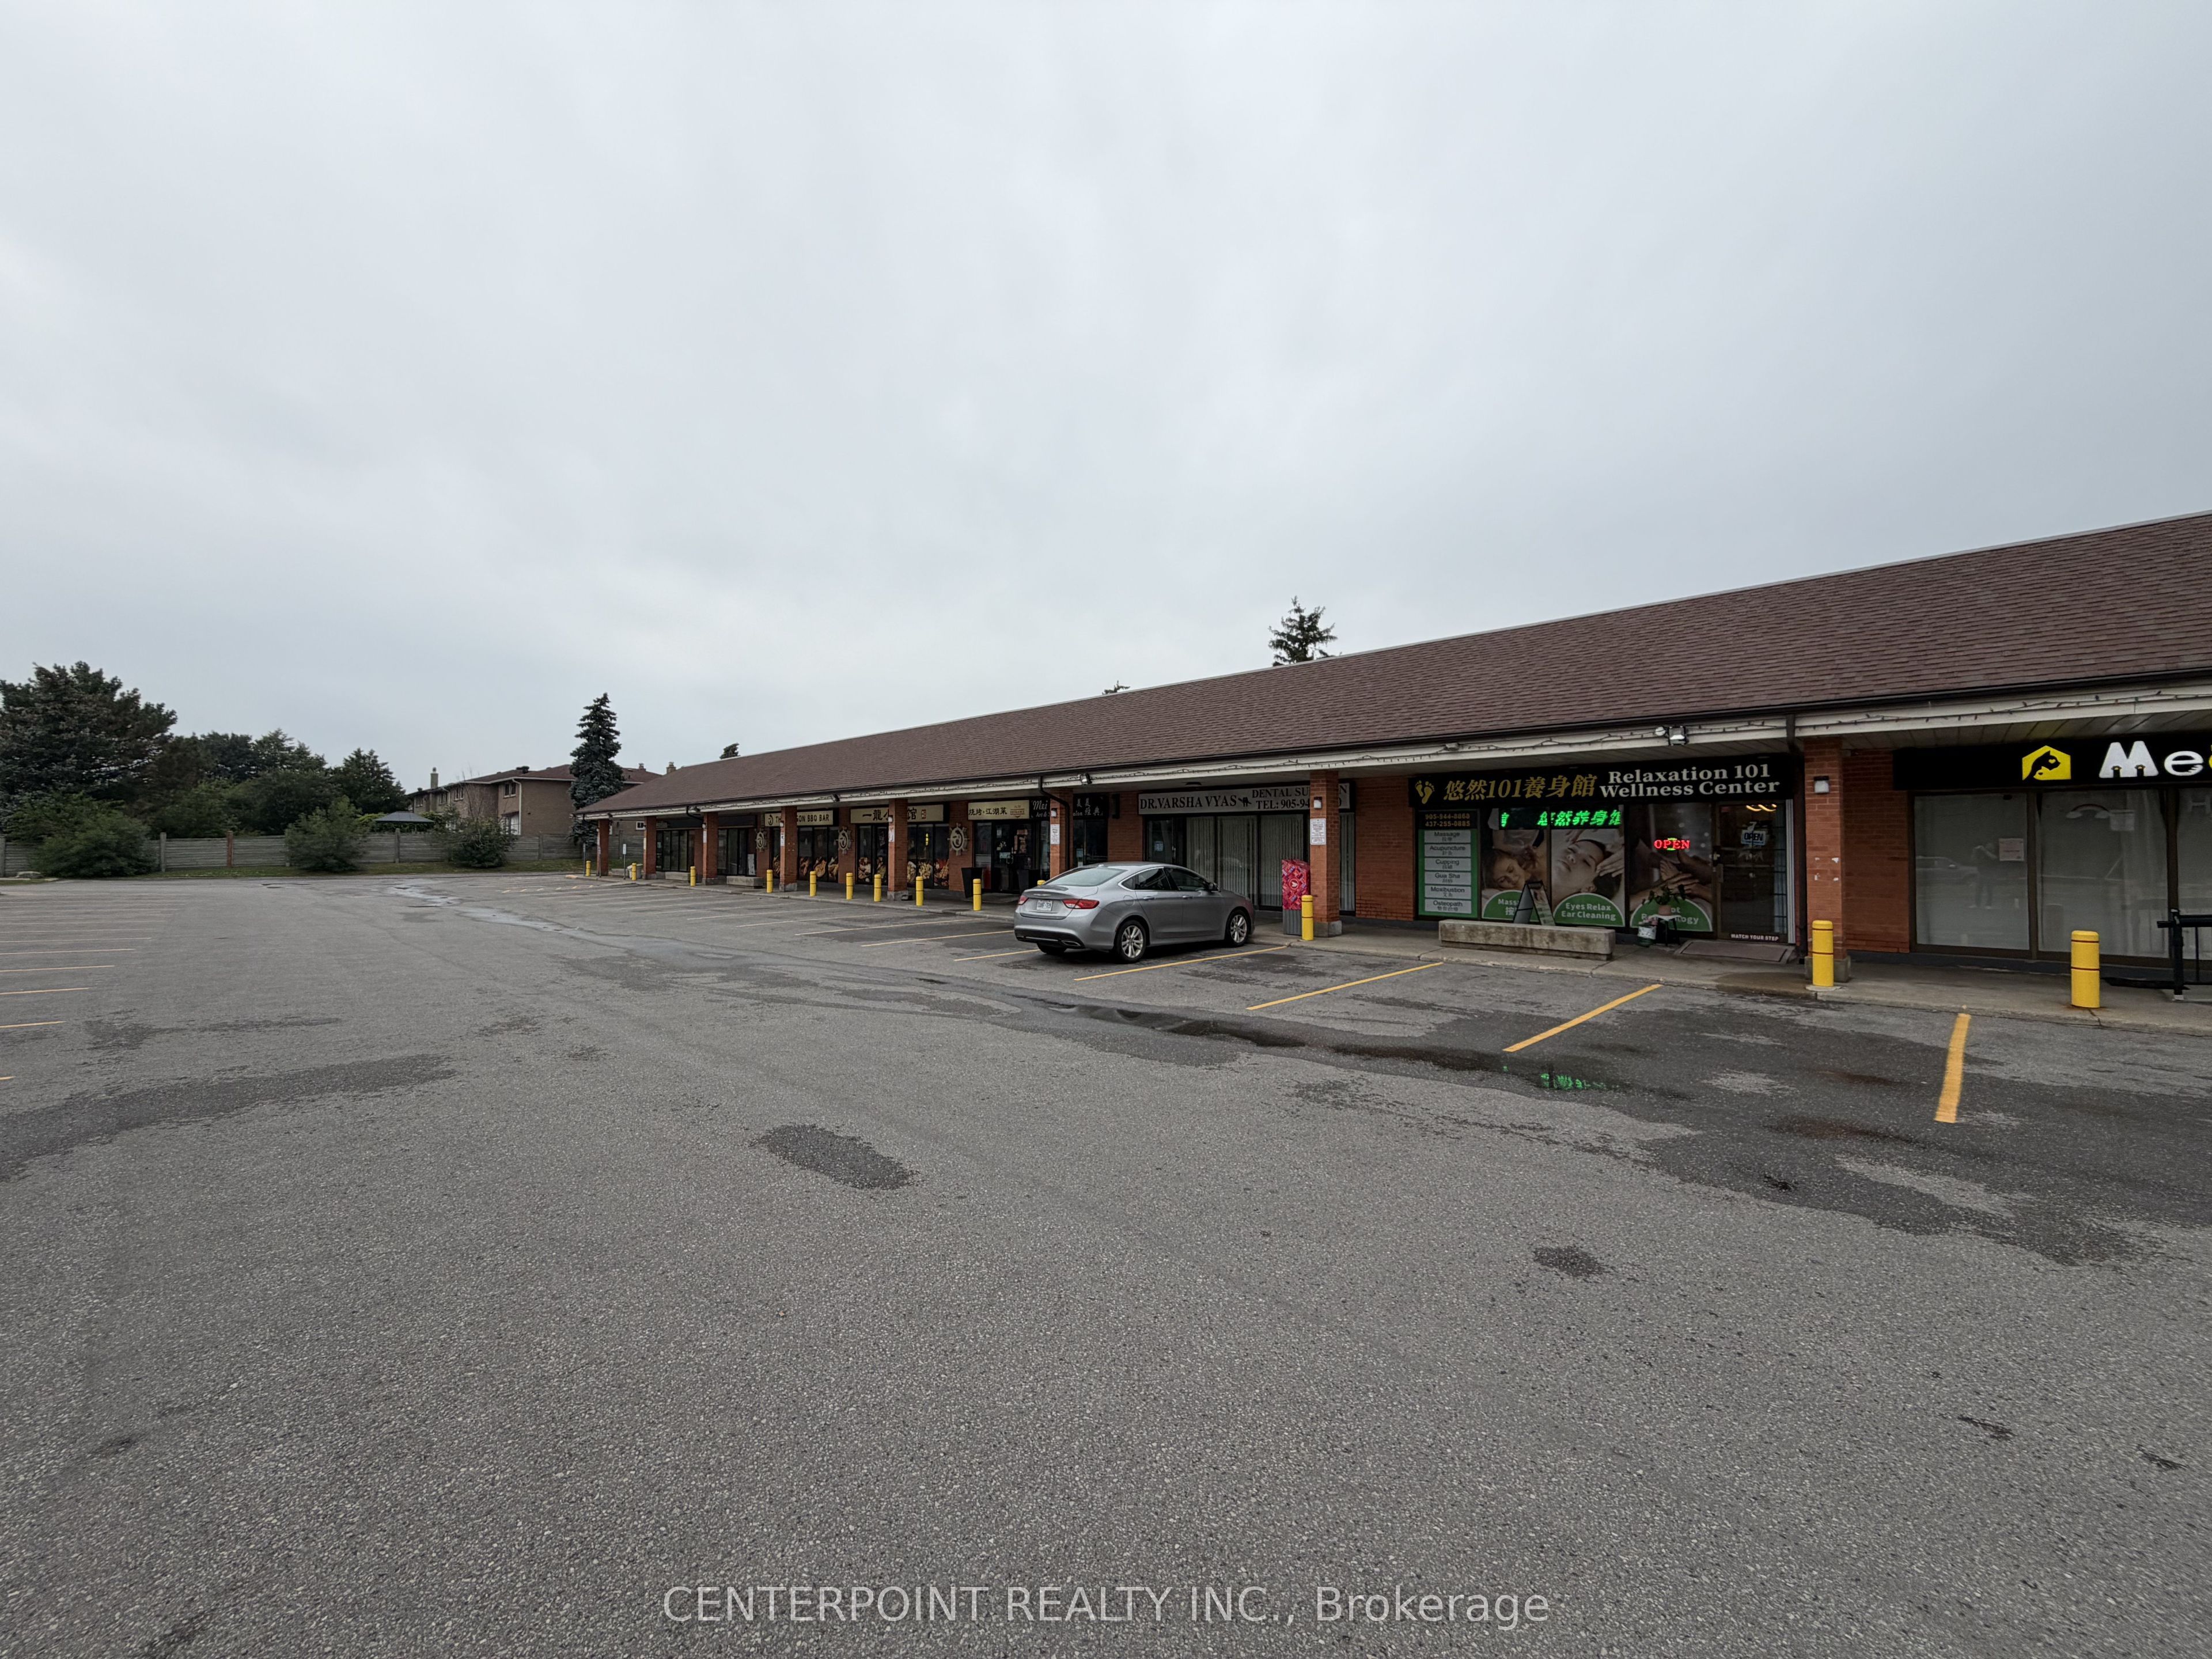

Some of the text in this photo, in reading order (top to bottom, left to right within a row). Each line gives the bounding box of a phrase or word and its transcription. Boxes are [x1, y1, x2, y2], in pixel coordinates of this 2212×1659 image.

[2099, 740, 2212, 778] Me
[1608, 764, 1770, 784] Relaxation 101
[1252, 787, 1291, 798] DENTAL
[1443, 774, 1597, 801] 悠然101養身館
[1599, 781, 1781, 798] Wellness Center
[1206, 794, 1237, 808] VYAS
[1256, 799, 1278, 810] TEL:
[1744, 832, 1763, 841] OPEN
[1654, 840, 1690, 849] OPEN
[1565, 902, 1612, 911] Eyes Relax
[1577, 911, 1616, 922] Cleaning
